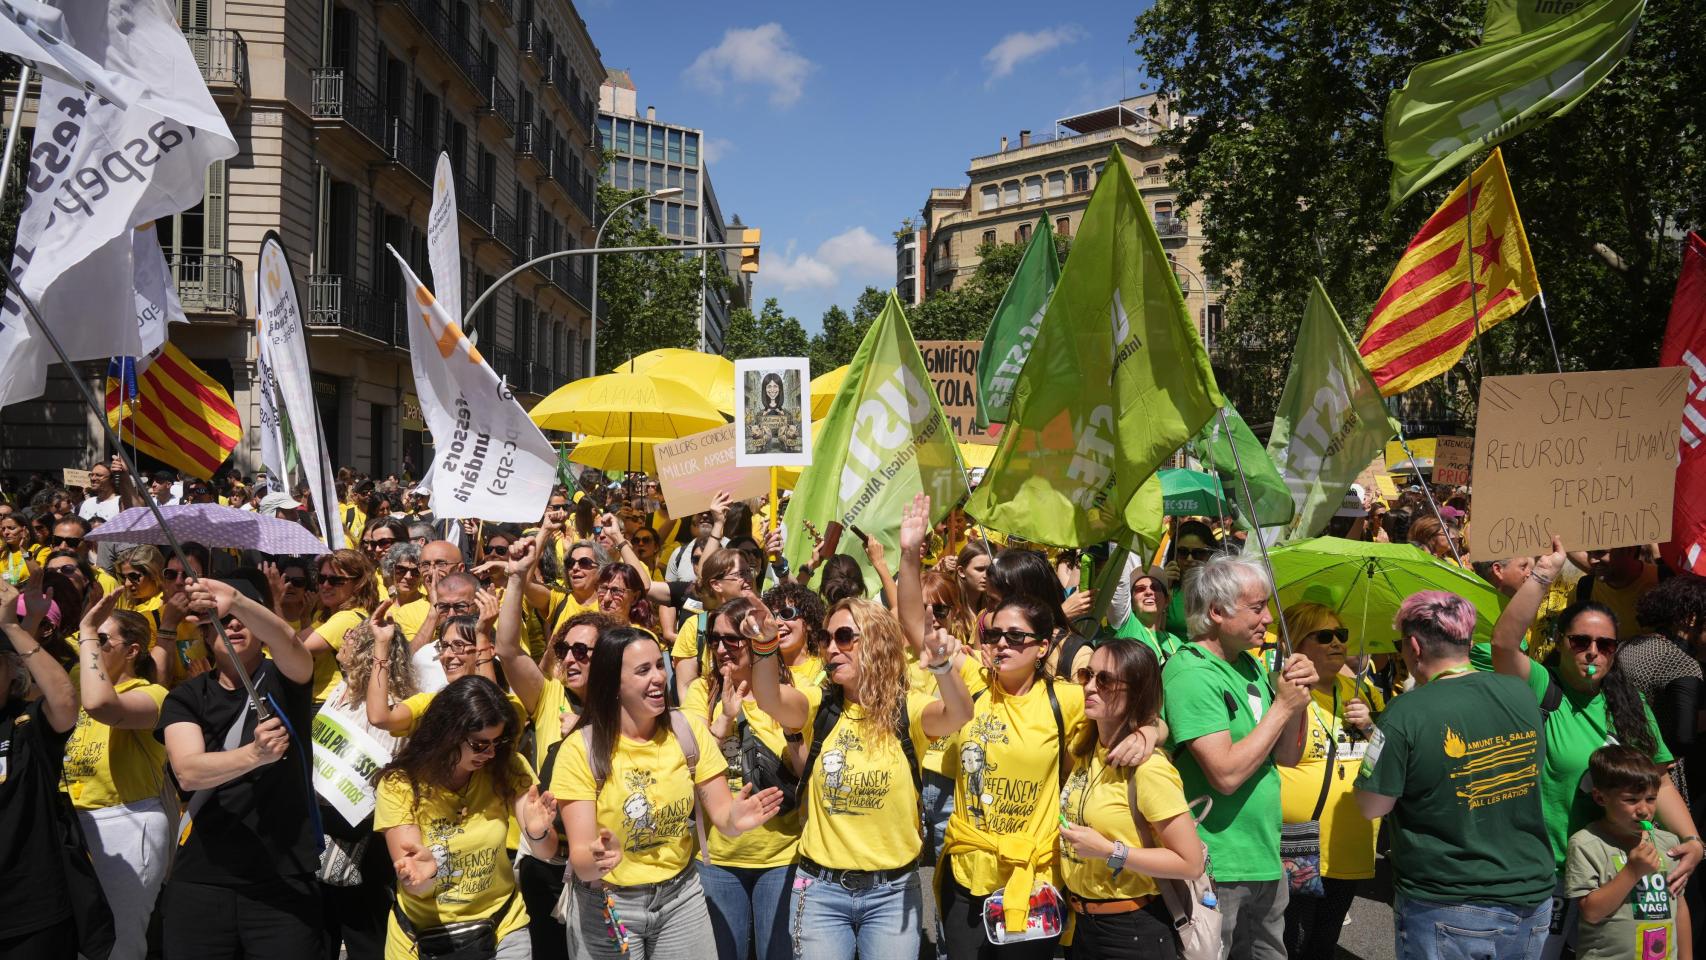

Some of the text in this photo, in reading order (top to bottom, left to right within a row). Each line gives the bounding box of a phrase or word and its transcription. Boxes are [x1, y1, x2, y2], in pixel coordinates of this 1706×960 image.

[931, 378, 975, 407] COLA
[1540, 379, 1634, 425] SENSE
[658, 439, 698, 460] MILLORS
[1486, 436, 1588, 473] RECURSOS
[1614, 420, 1679, 464] HUMANS
[662, 458, 700, 480] MILLOR
[1550, 475, 1634, 509] PERDEM
[1488, 514, 1552, 554] GRANS
[1495, 736, 1505, 744] EL
[1487, 796, 1501, 805] LES
[1636, 891, 1668, 903] FAIG
[1638, 903, 1669, 913] VAGA
